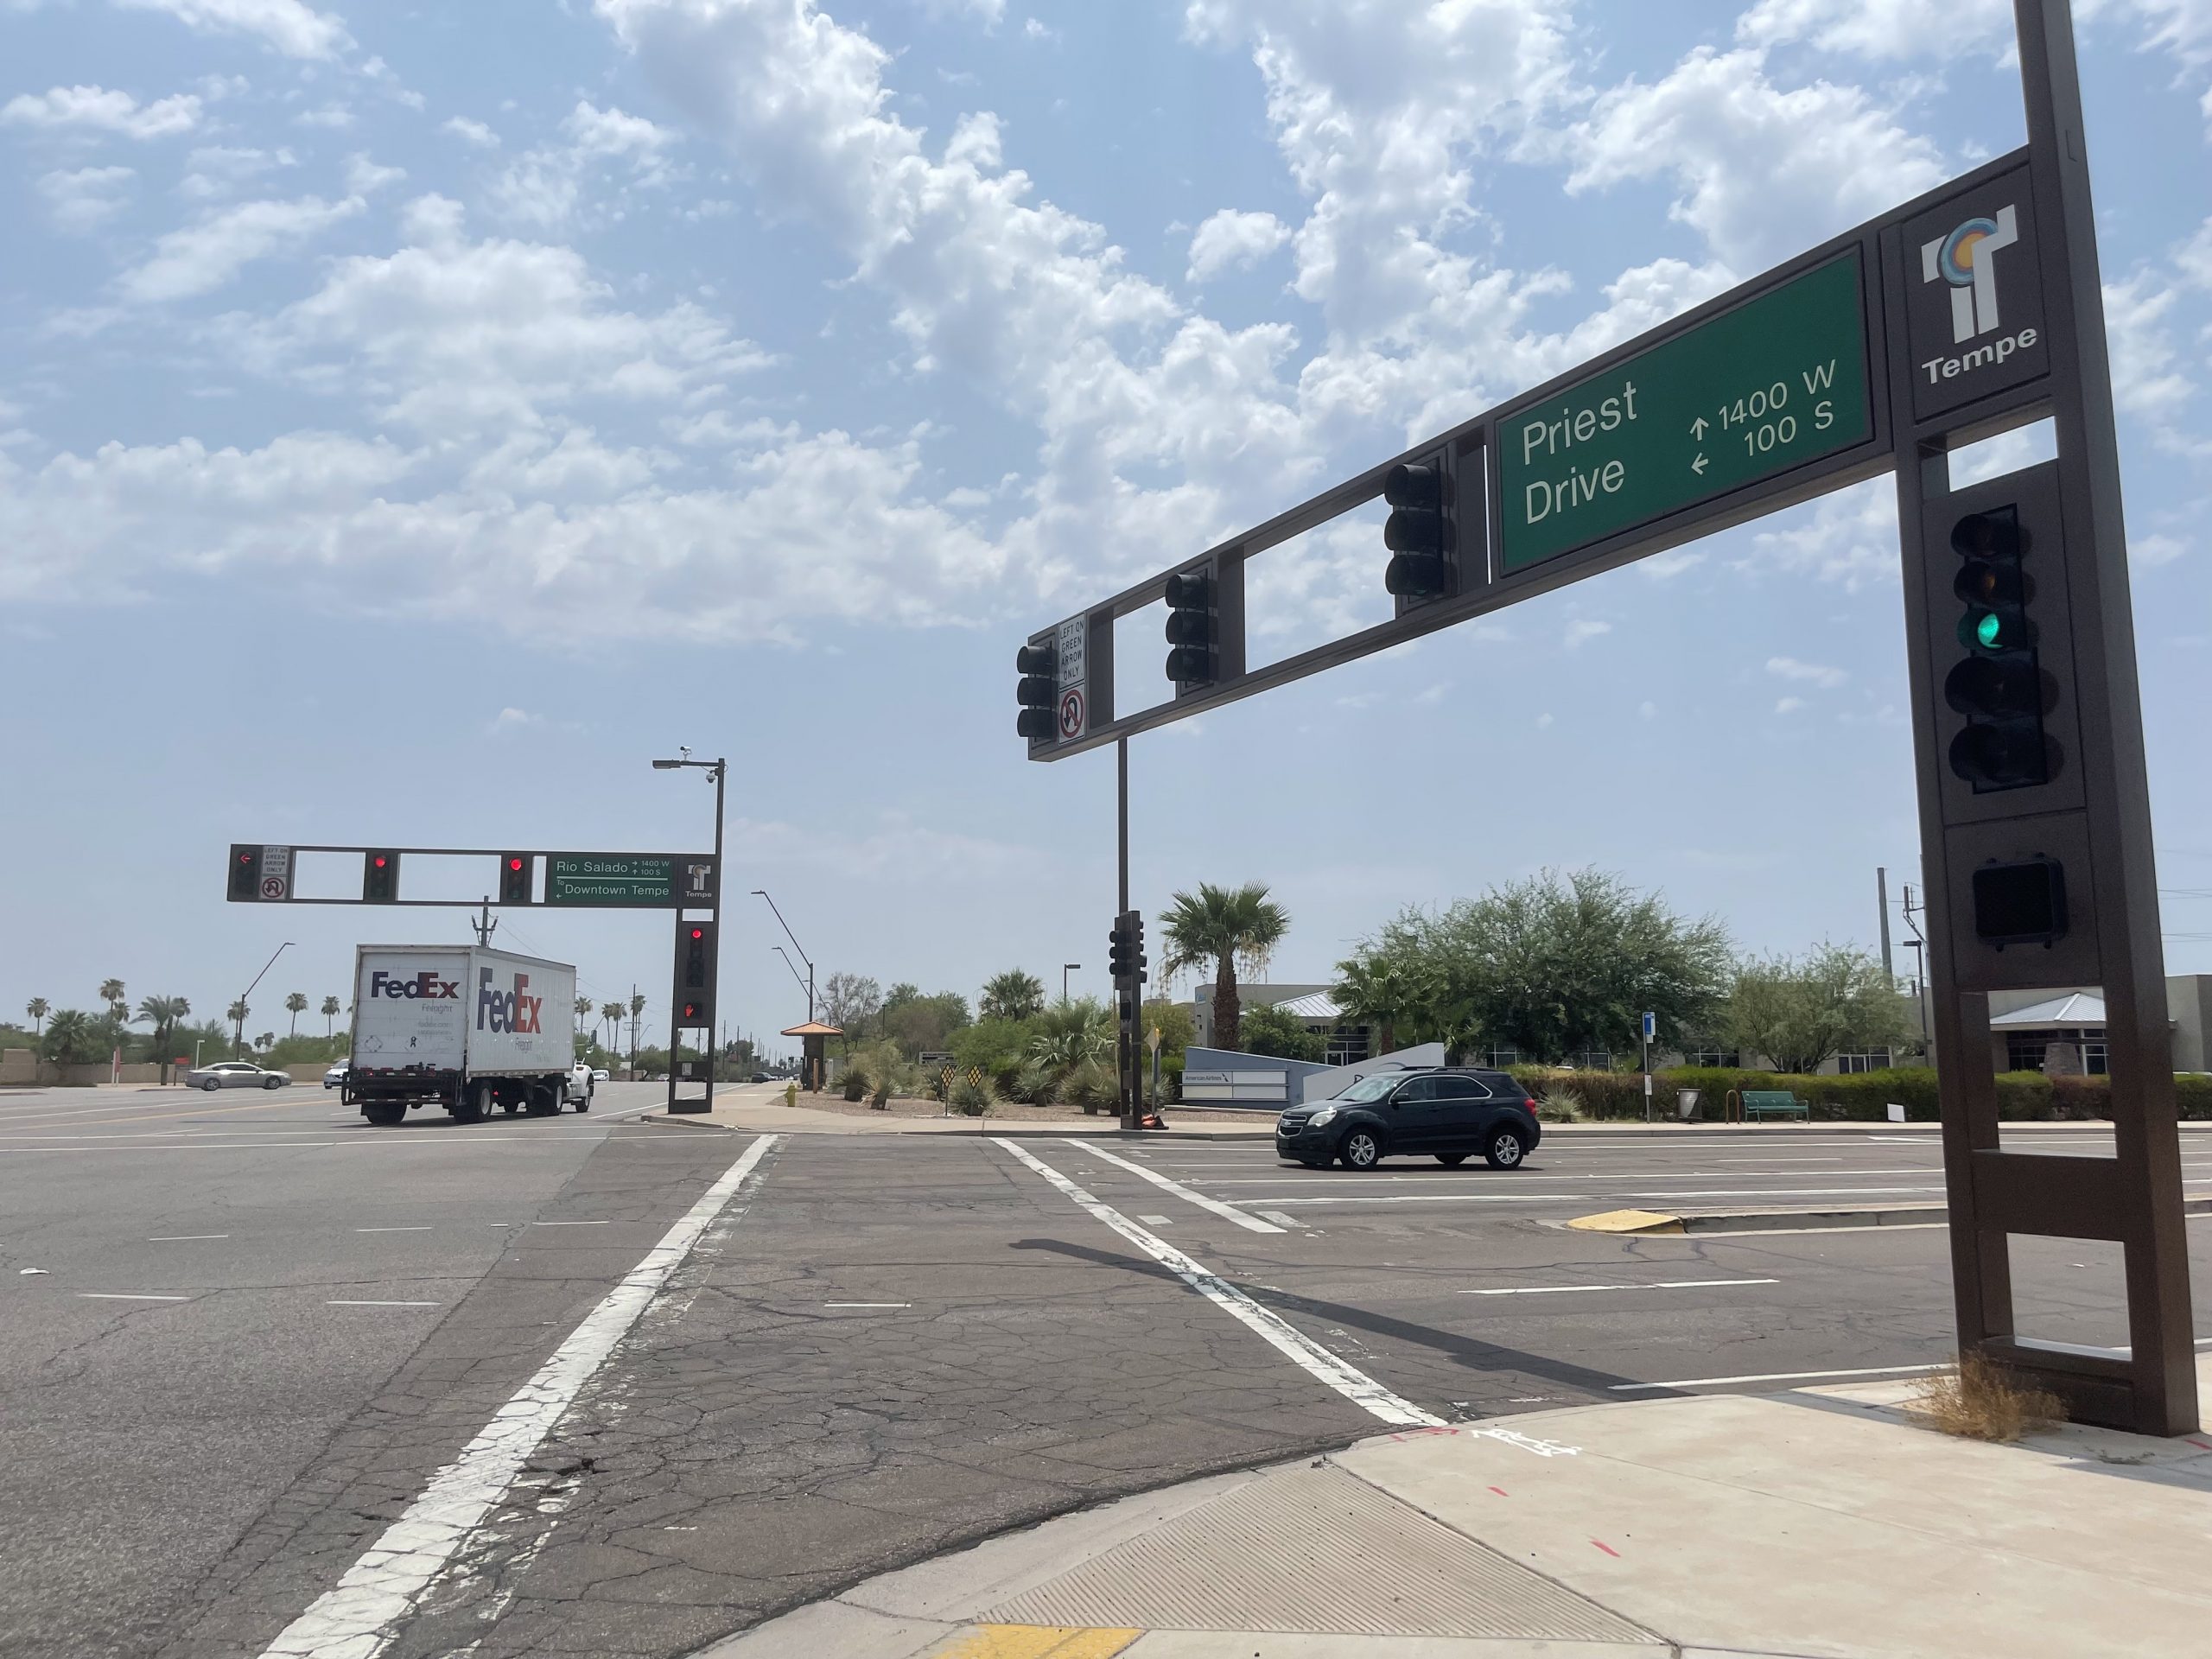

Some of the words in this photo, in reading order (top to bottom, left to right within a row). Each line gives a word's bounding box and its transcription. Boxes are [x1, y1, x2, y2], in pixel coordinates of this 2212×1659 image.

[1921, 327, 2037, 385] Tempe
[1719, 381, 1789, 430] 1400
[1802, 359, 1837, 395] W
[1522, 380, 1638, 466] Priest
[1744, 414, 1797, 458] 100
[1815, 400, 1834, 430] S
[1525, 458, 1625, 525] Drive
[1060, 624, 1074, 639] LEFT
[1075, 620, 1084, 632] ON
[1061, 635, 1082, 652] GREEN
[1061, 649, 1083, 665] ARROW
[1064, 666, 1079, 681] ONLY
[556, 861, 577, 872] Rio
[583, 861, 628, 873] Salado
[565, 884, 626, 895] Downtown
[632, 885, 670, 897] Tempe
[685, 890, 712, 899] Tempe
[371, 971, 460, 1000] FedEx
[477, 967, 543, 1034] FedEx
